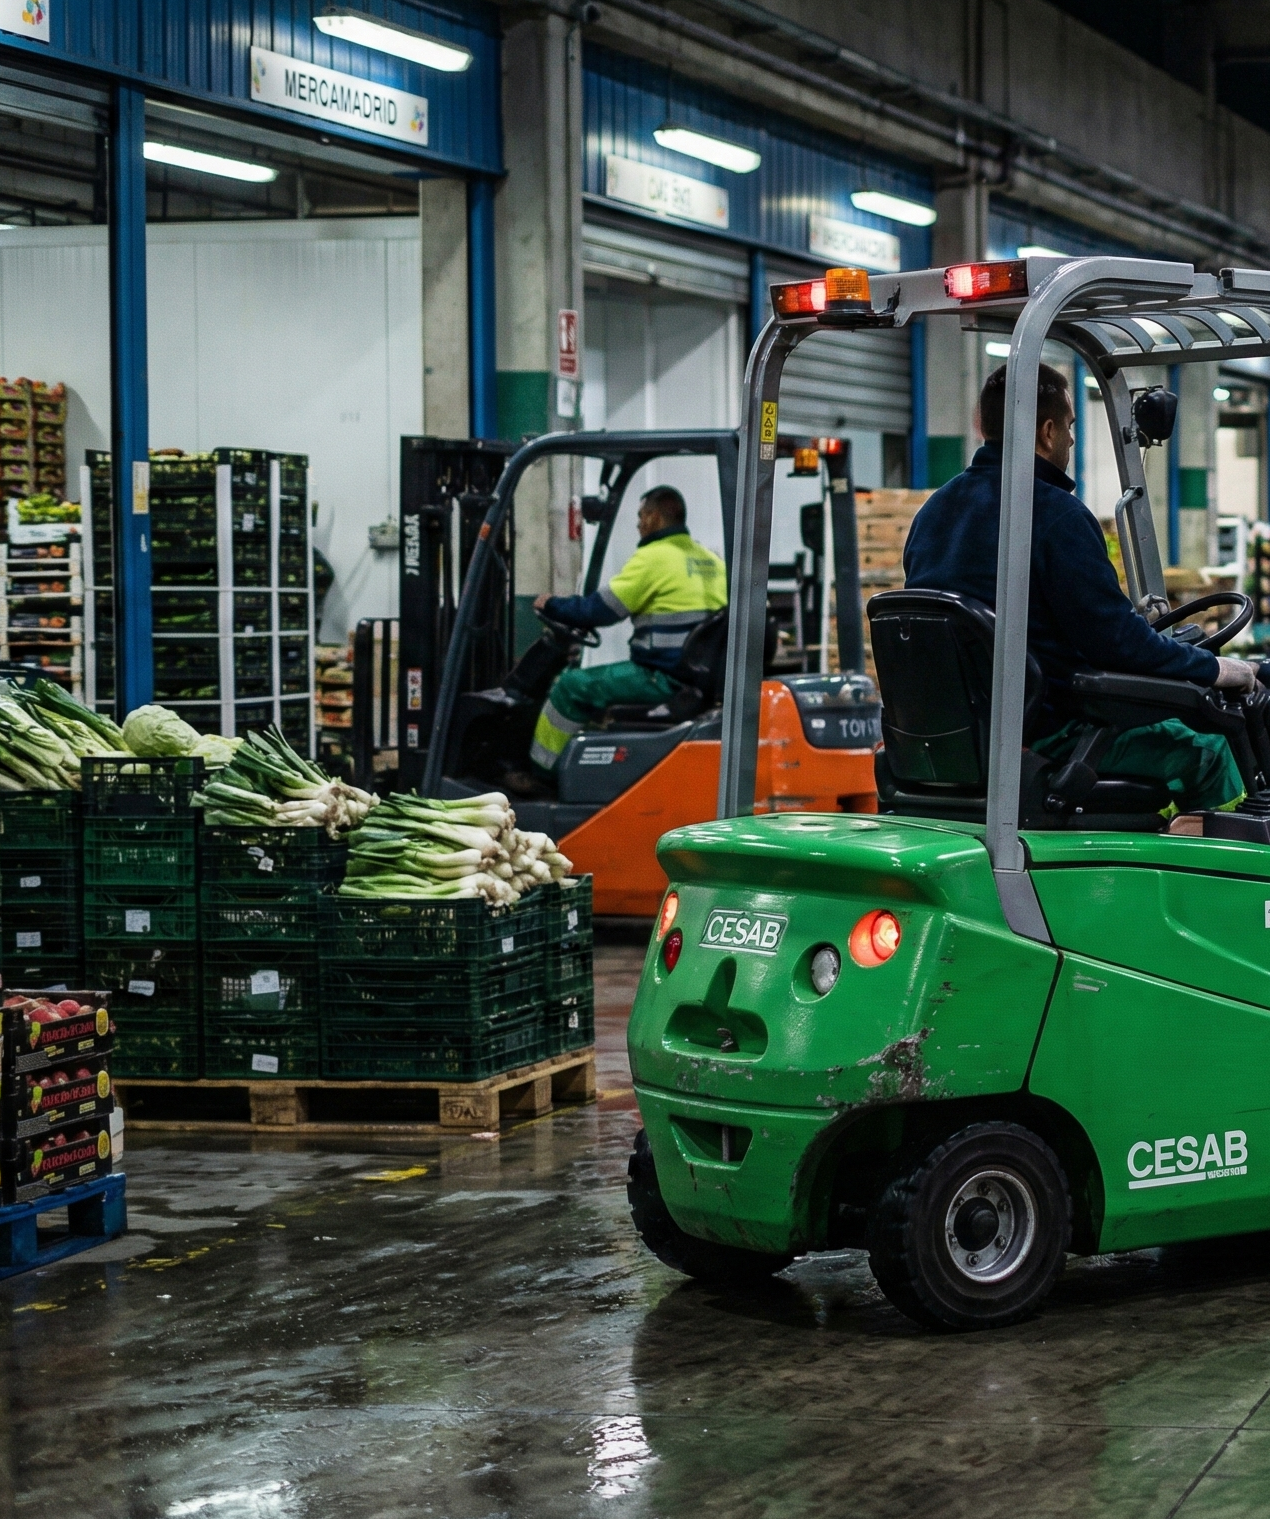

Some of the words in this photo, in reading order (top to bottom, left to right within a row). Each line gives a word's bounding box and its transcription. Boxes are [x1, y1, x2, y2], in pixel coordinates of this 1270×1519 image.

[284, 68, 398, 125] MERCAMADRID
[707, 915, 781, 948] CESAB
[1126, 1129, 1248, 1179] CESAB
